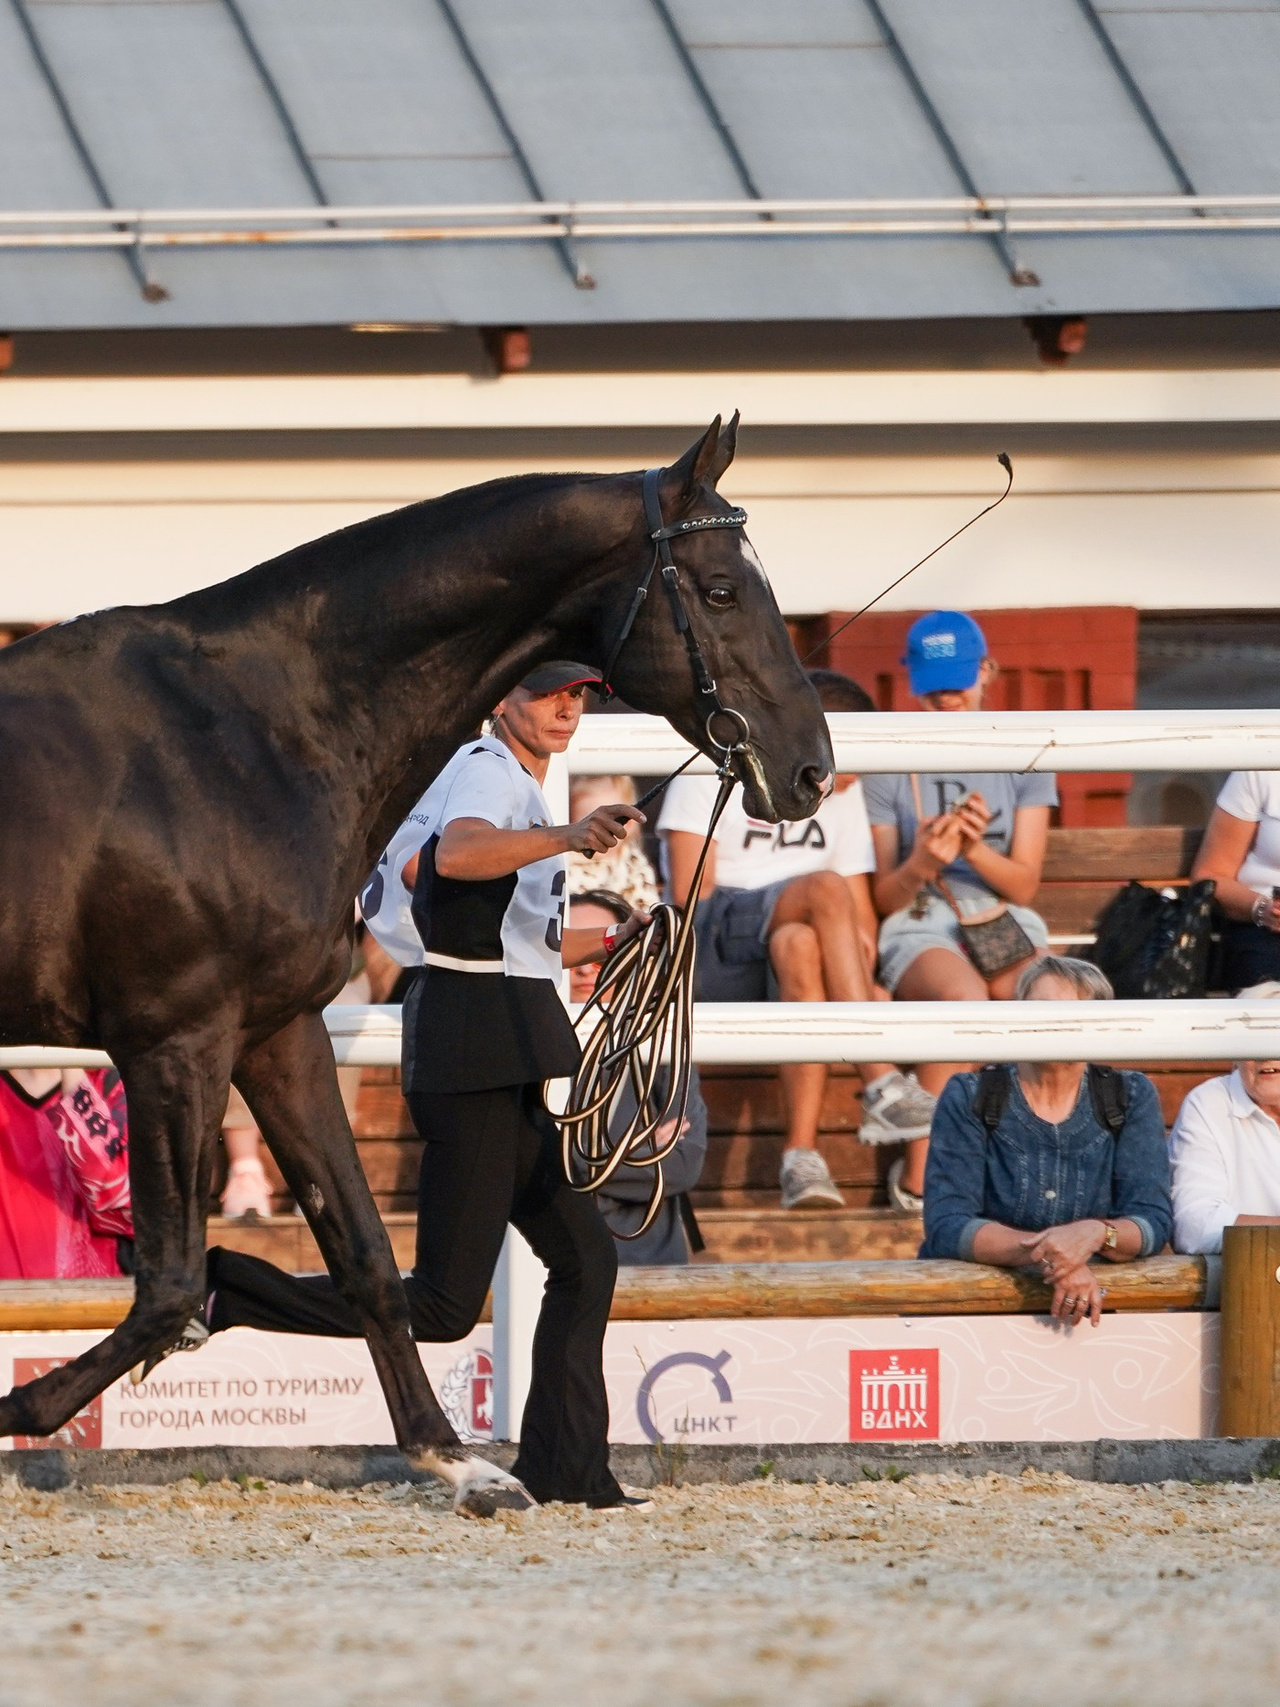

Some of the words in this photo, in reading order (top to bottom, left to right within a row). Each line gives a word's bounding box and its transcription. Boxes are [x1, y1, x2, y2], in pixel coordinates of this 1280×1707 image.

[119, 1381, 221, 1400] КОМИТЕТ
[227, 1380, 258, 1397] ПО
[263, 1377, 364, 1397] ТУРИЗМУ
[119, 1410, 205, 1430] ГОРОДА
[211, 1407, 307, 1426] МОСКВЫ
[673, 1415, 738, 1435] ЦНКТ
[860, 1410, 928, 1430] ВДНХ
